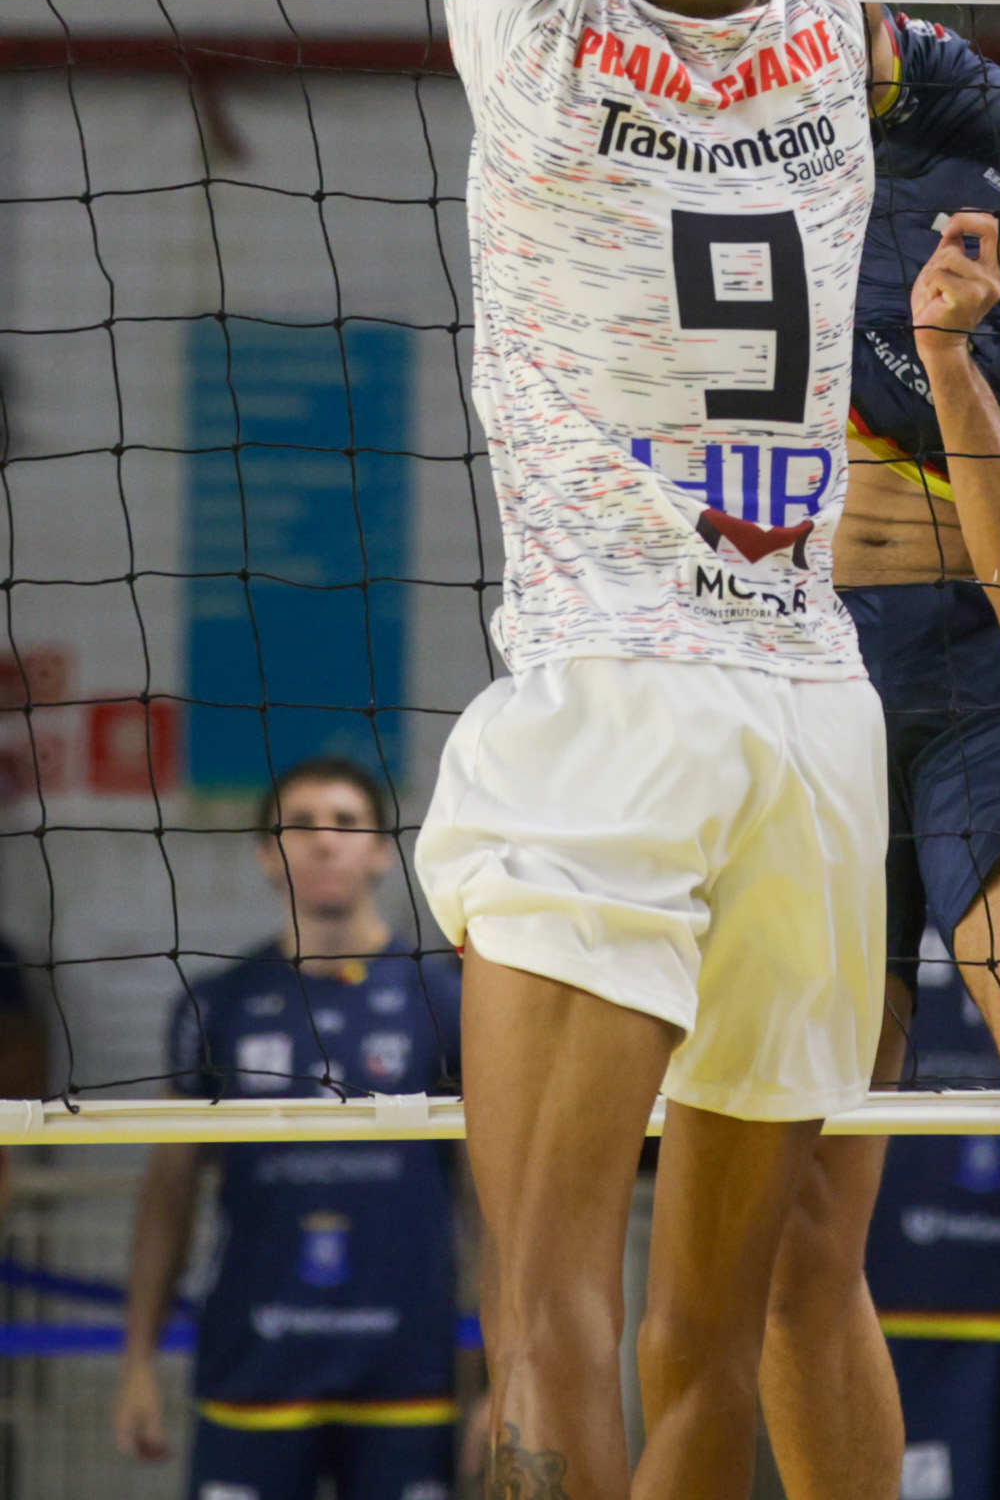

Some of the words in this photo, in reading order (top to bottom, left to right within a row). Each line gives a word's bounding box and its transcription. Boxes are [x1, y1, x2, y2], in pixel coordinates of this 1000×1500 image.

[573, 26, 692, 104] PRAIA
[598, 99, 836, 173] Trasmontano
[783, 145, 846, 185] Saúde
[671, 209, 811, 424] 9
